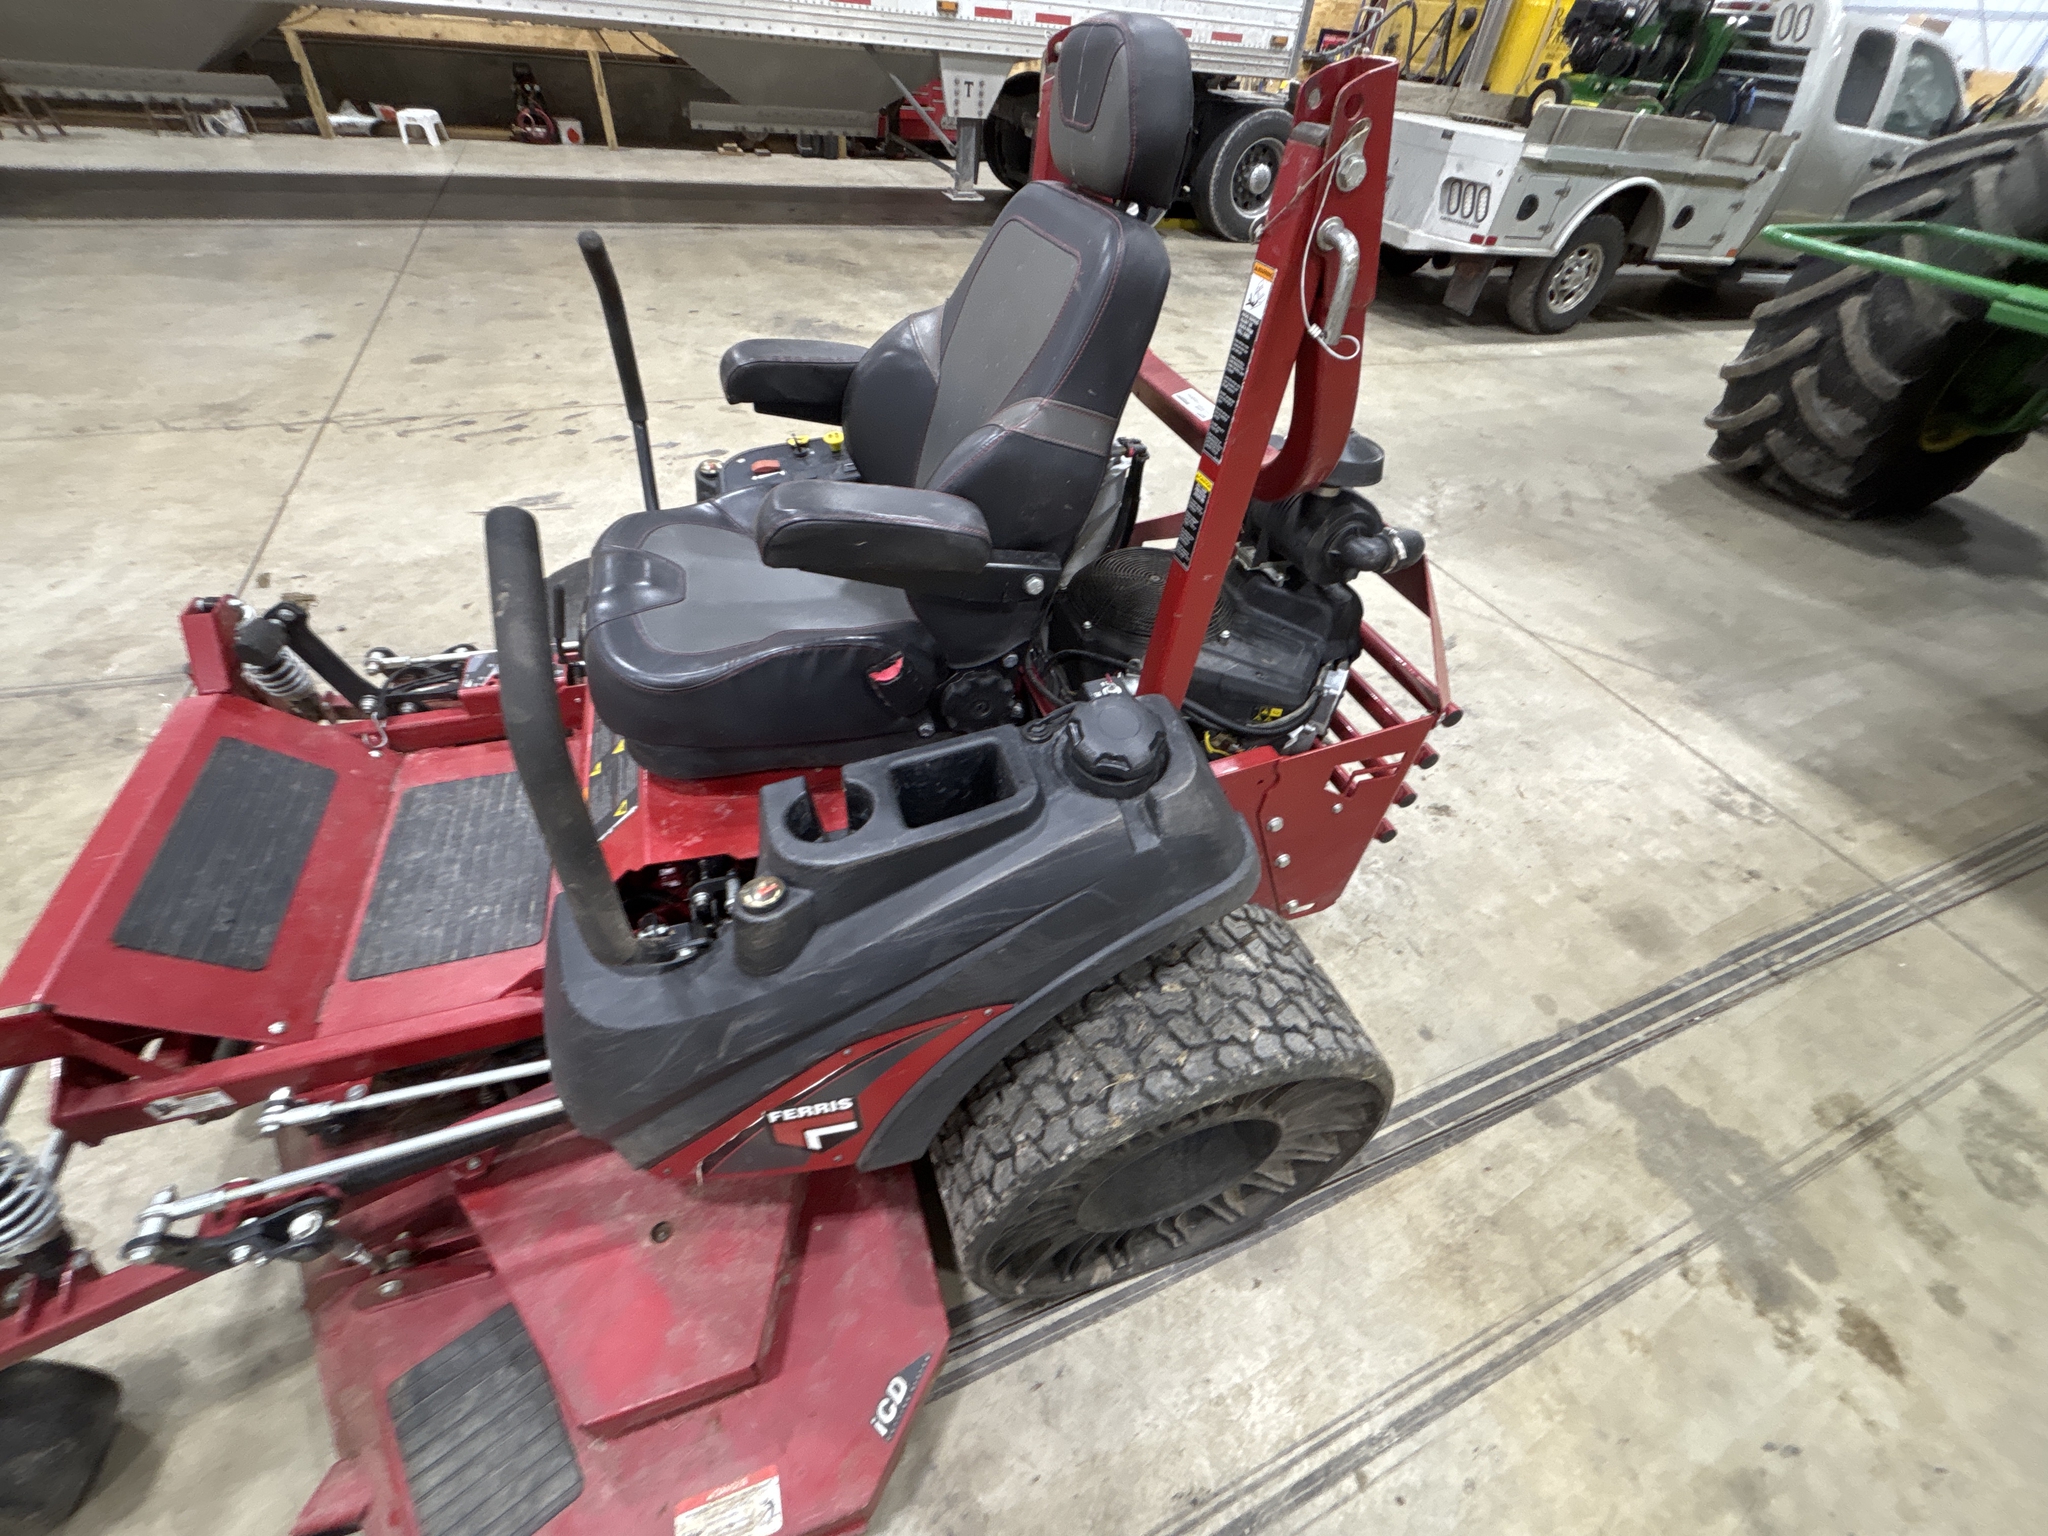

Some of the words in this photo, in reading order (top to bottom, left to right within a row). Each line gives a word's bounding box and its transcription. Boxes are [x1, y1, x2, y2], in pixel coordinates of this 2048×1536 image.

[964, 81, 974, 97] T
[766, 1097, 854, 1124] FERRIS
[869, 1375, 908, 1437] iCD
